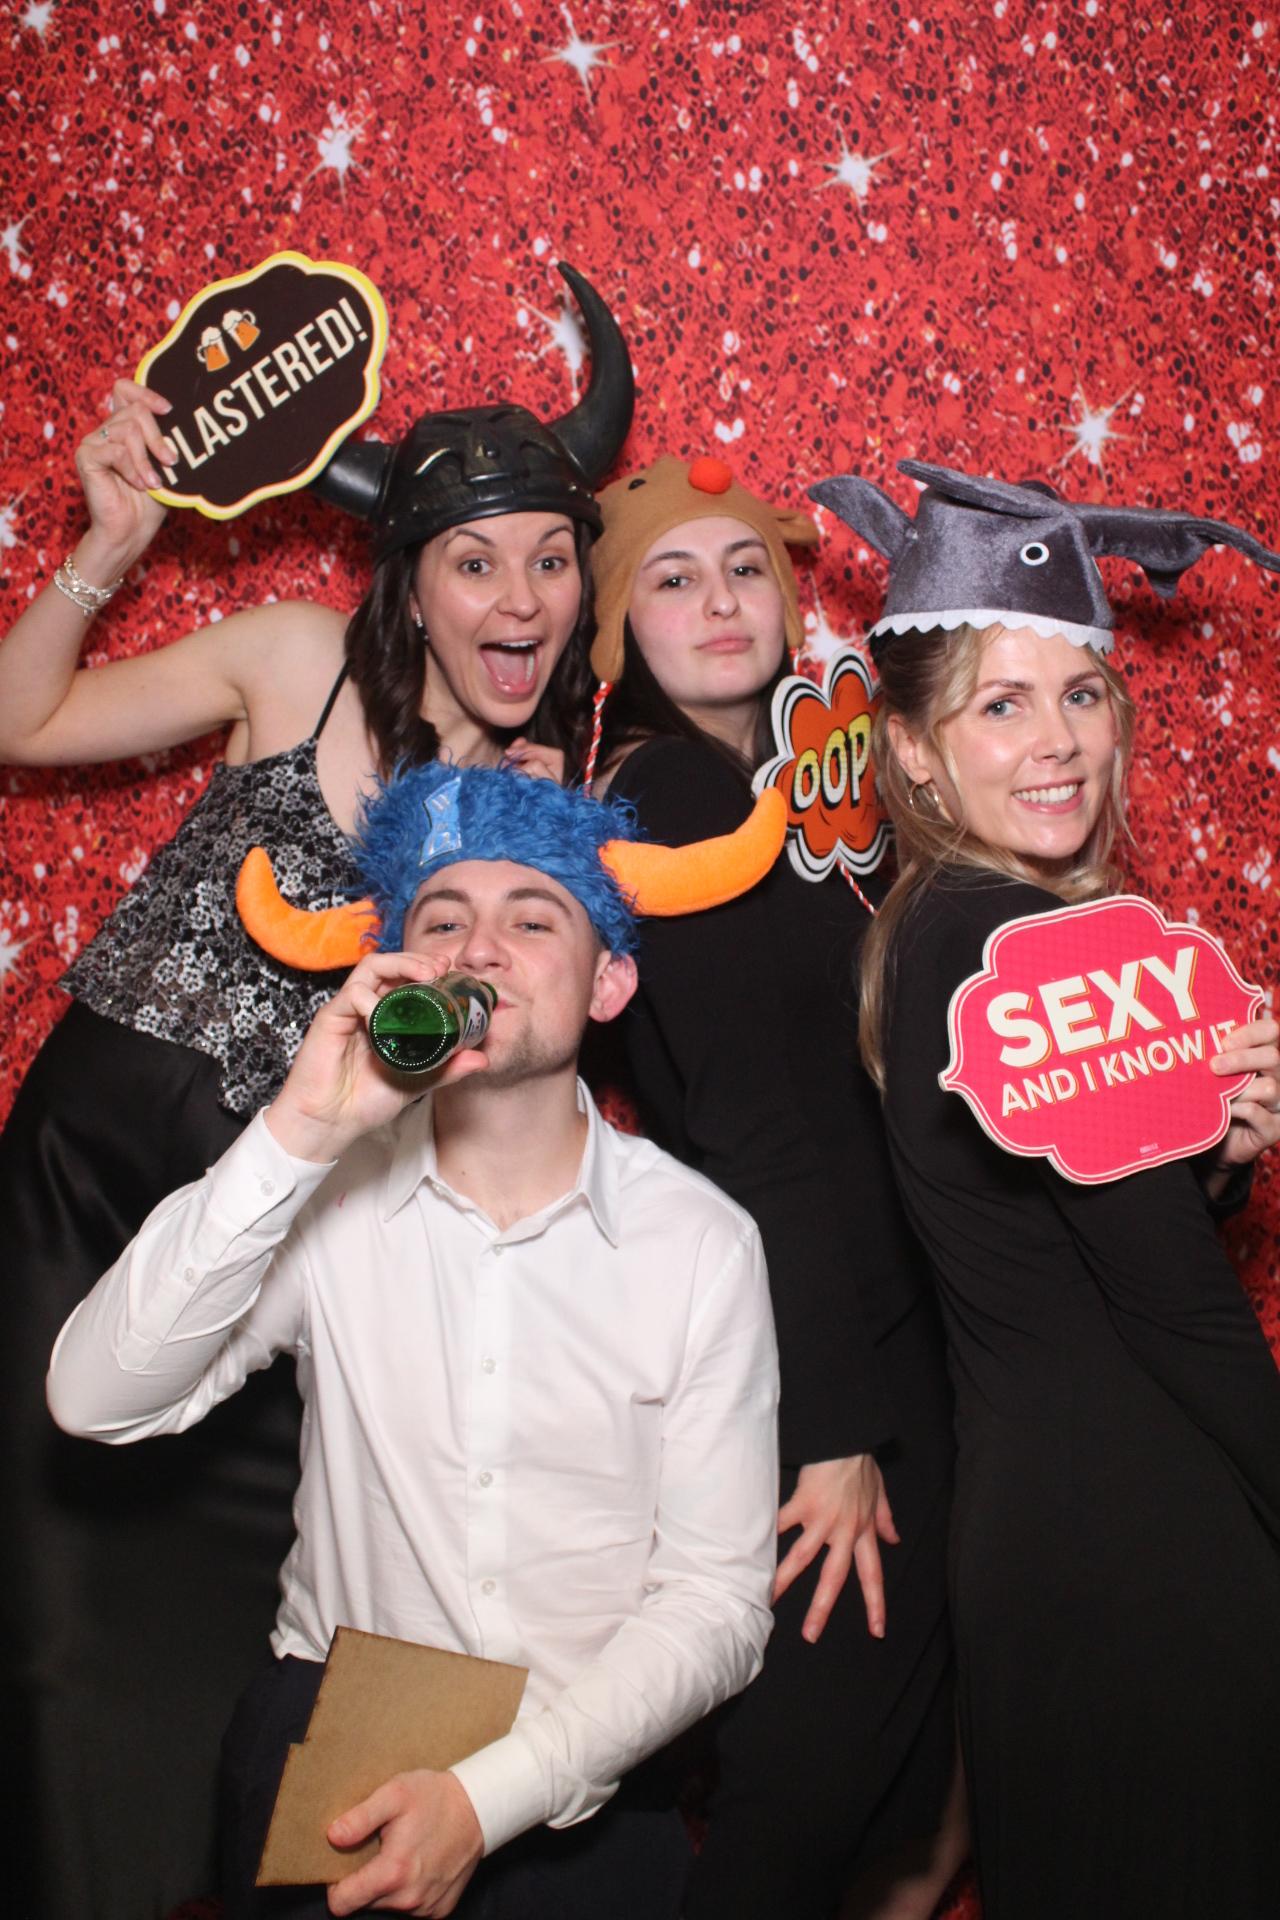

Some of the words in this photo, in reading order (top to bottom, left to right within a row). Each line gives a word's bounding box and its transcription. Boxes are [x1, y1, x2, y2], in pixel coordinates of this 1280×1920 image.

[790, 711, 872, 814] OOP
[986, 945, 1200, 1068] SEXY
[1001, 1067, 1080, 1118] AND
[1081, 1060, 1099, 1093] I
[1099, 1029, 1205, 1088] KNOW
